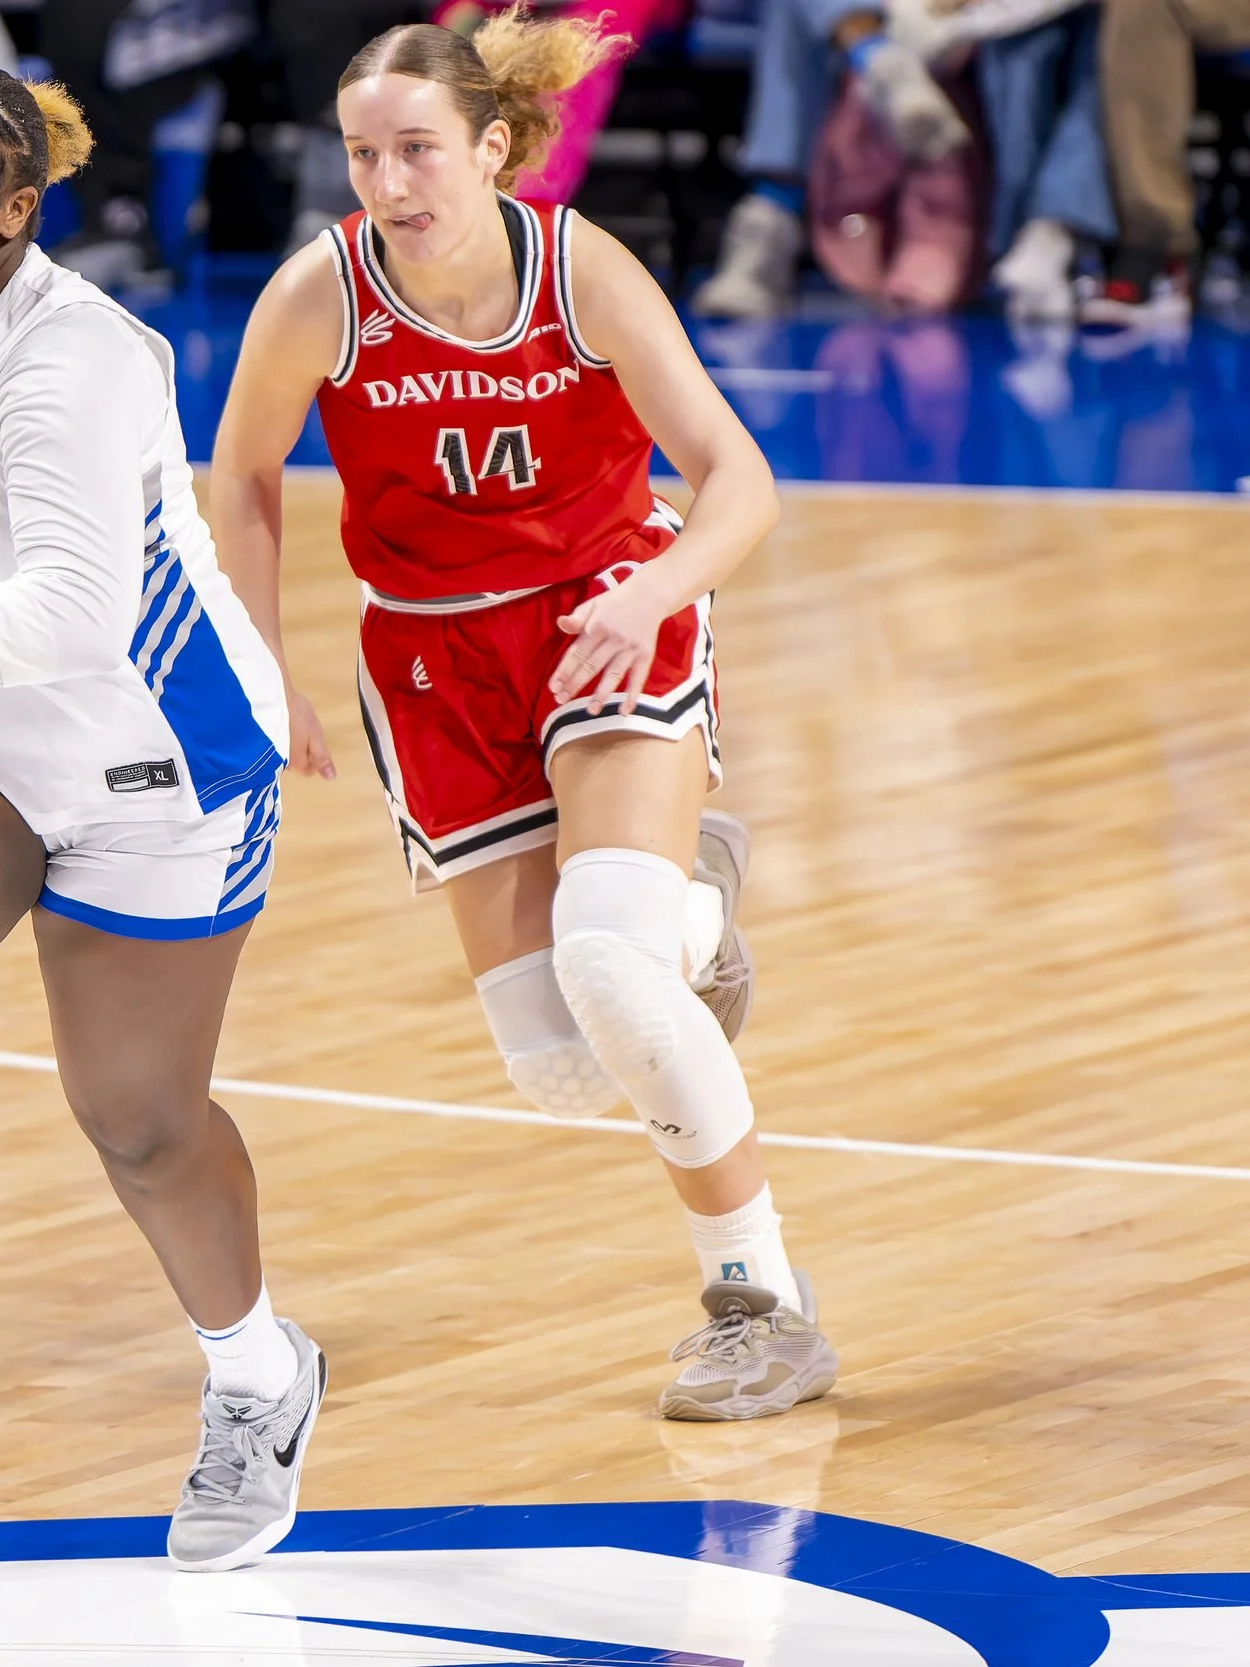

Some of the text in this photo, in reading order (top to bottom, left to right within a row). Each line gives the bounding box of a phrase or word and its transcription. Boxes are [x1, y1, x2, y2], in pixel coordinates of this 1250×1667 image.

[362, 359, 581, 407] DAVIDSON
[434, 424, 542, 496] 14
[153, 770, 169, 781] XL
